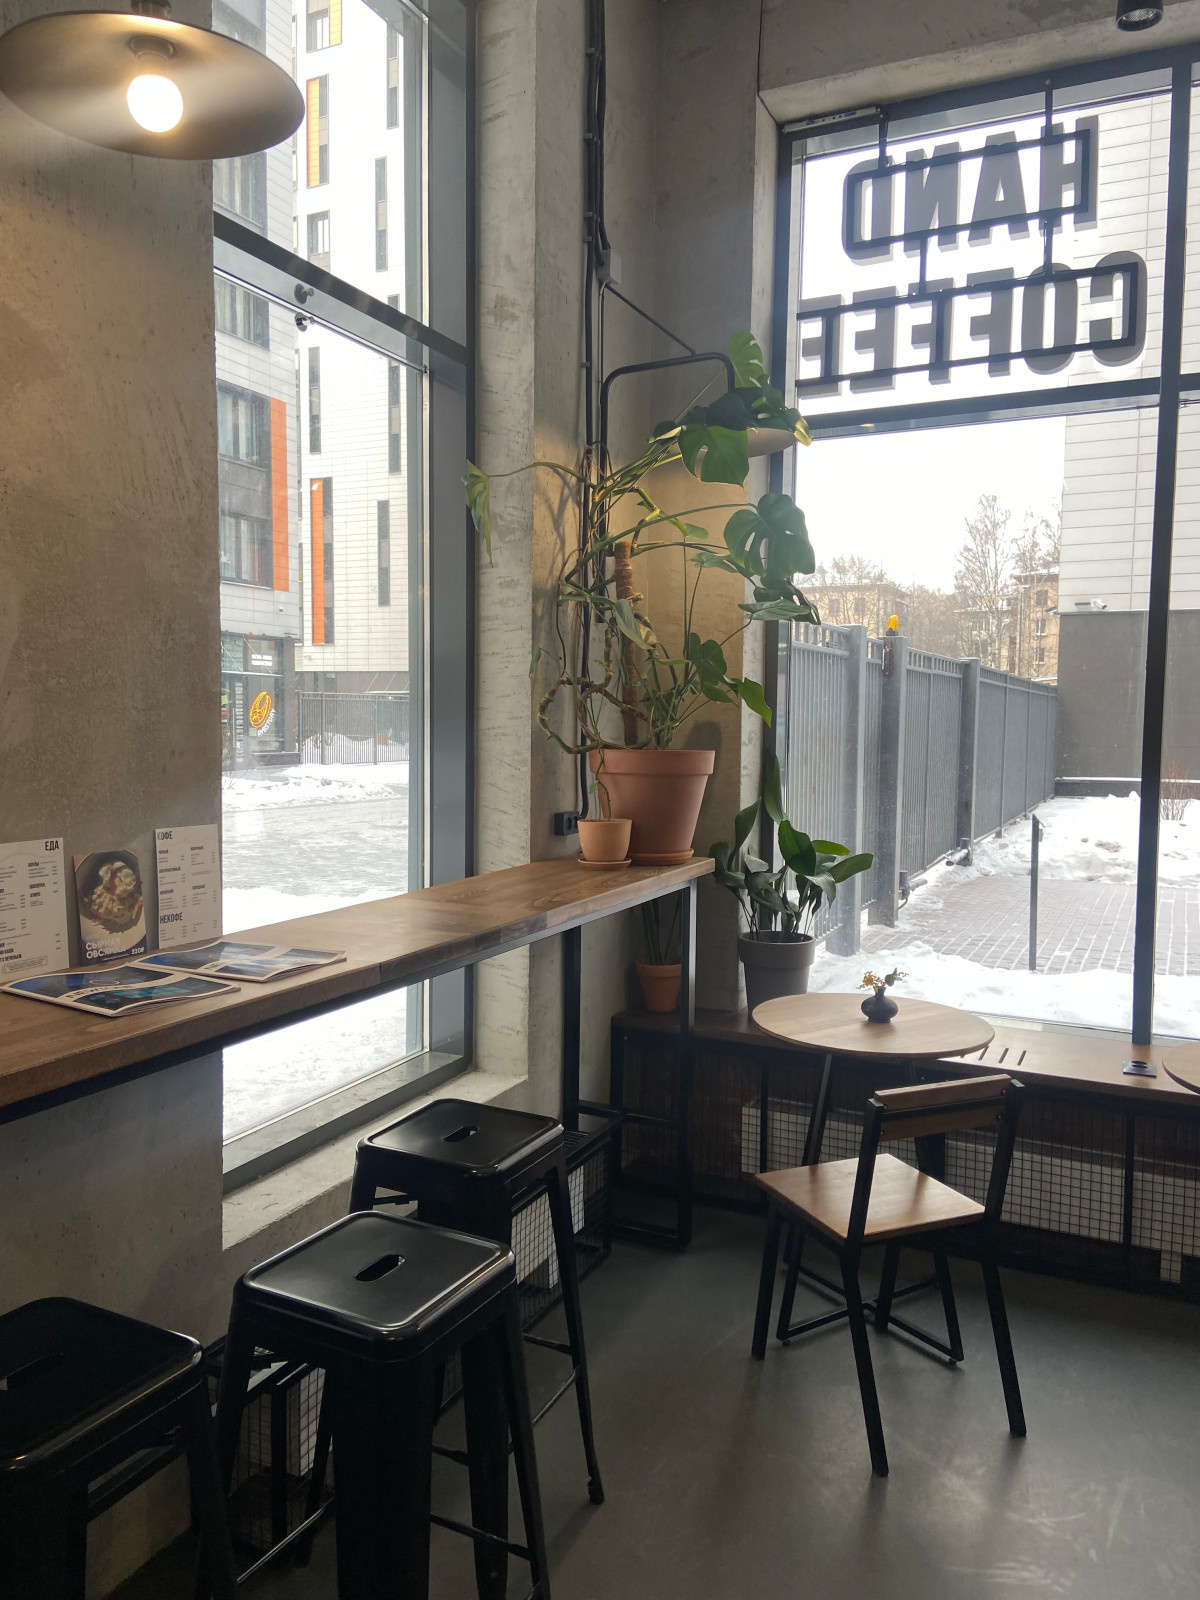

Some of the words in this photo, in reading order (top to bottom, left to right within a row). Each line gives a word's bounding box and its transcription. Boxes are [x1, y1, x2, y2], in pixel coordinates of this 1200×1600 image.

[156, 830, 173, 841] КОФЕ
[44, 840, 60, 851] ЕДА
[159, 912, 183, 925] НЕКОФЕ
